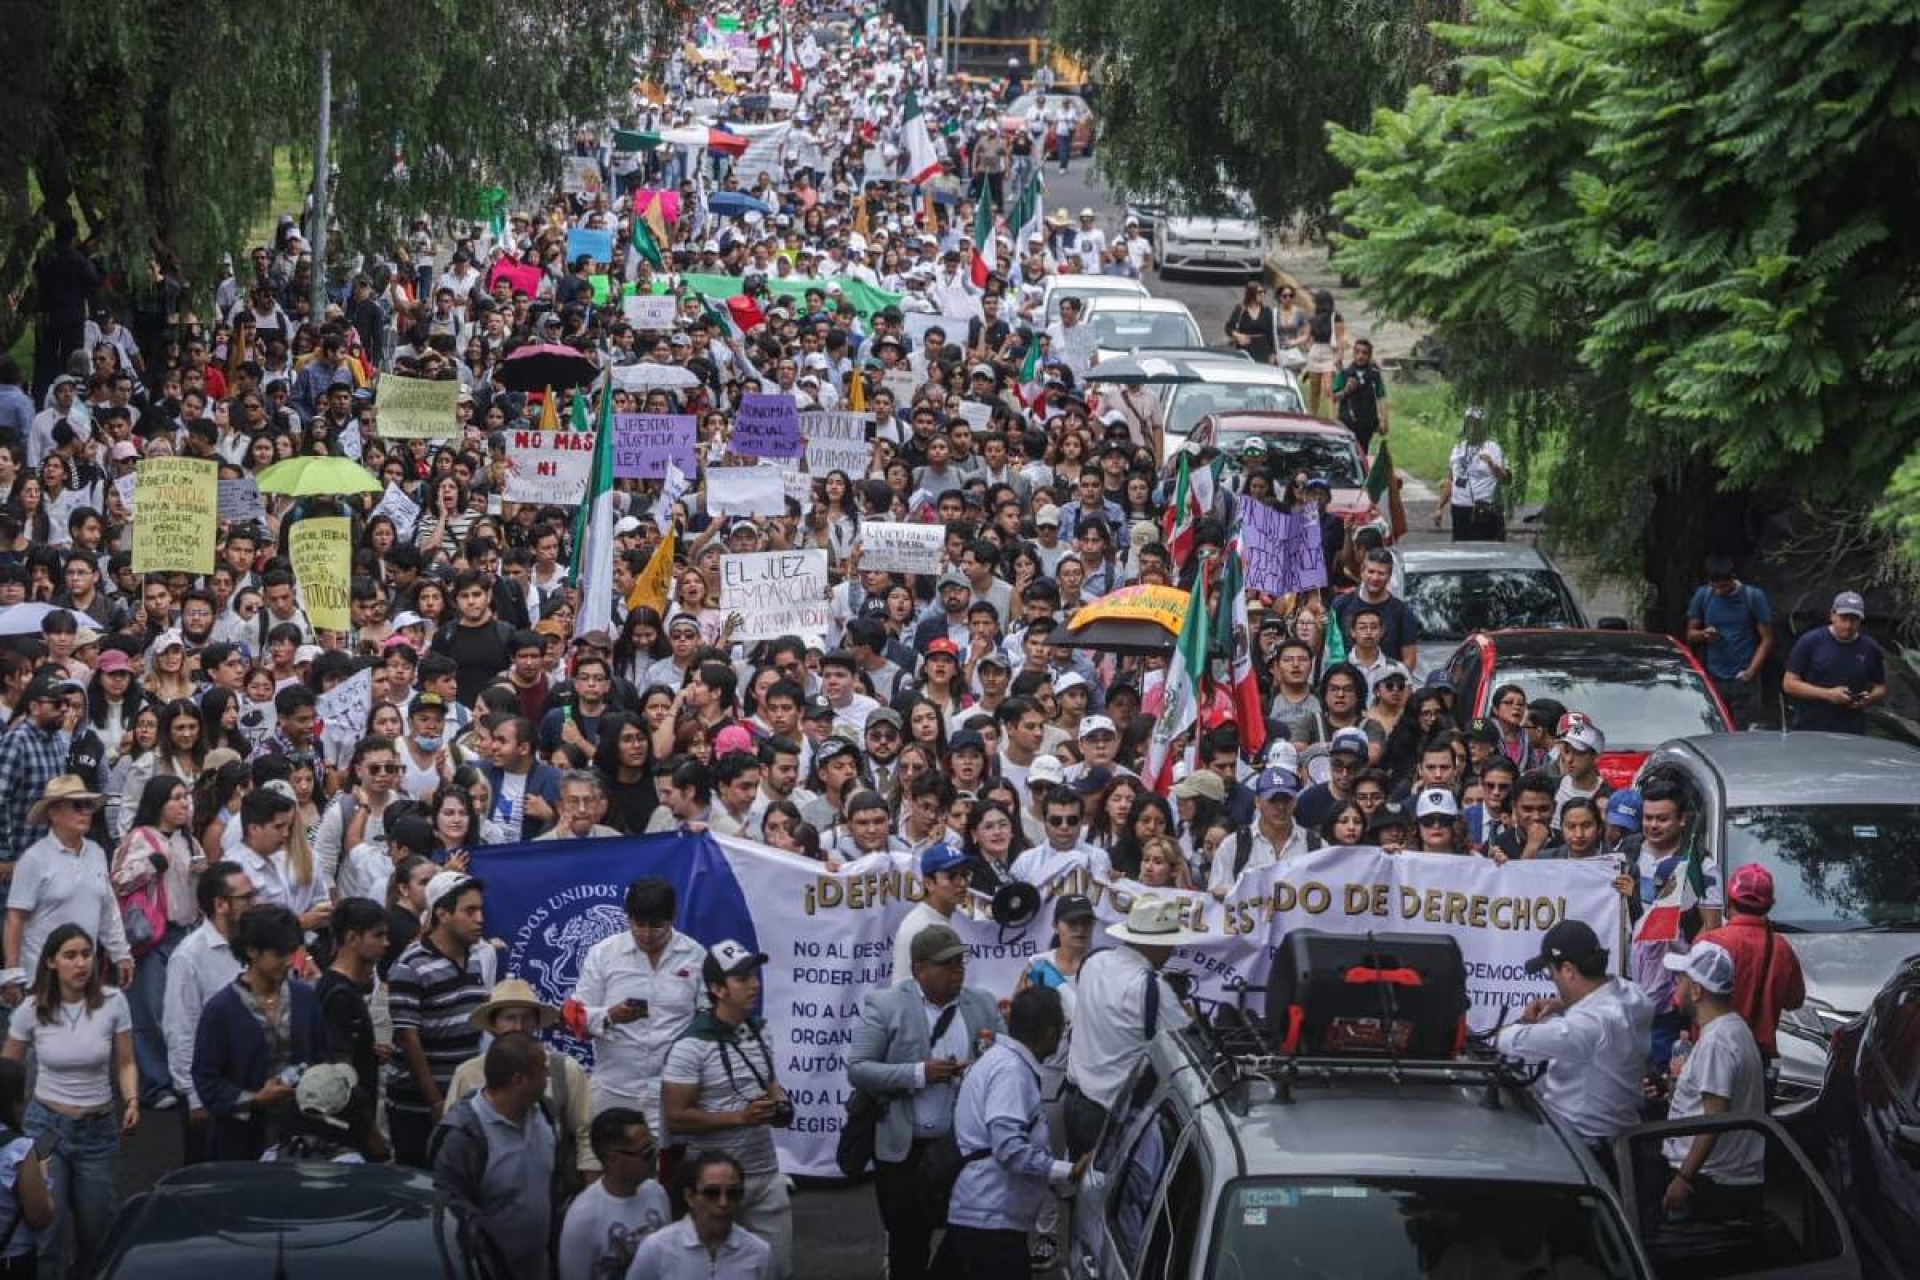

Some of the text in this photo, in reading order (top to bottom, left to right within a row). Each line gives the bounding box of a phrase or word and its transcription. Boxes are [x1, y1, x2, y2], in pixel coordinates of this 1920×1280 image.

[514, 430, 594, 451] NO MAS
[617, 432, 690, 449] JUSTICIA Y
[614, 451, 641, 467] LEY
[536, 460, 557, 477] NI
[726, 556, 811, 586] EL JUEZ
[1344, 884, 1390, 917] DE
[1400, 886, 1566, 931] DERECHO!
[509, 885, 619, 979] STADOS UNIDOS
[793, 940, 820, 958] NO
[826, 943, 849, 959] AL
[793, 967, 853, 985] PODER
[793, 1003, 861, 1019] NO A LA
[791, 1028, 852, 1046] ORGAN
[788, 1052, 850, 1073] AUTÓN
[788, 1089, 814, 1105] NO
[818, 1090, 830, 1105] A
